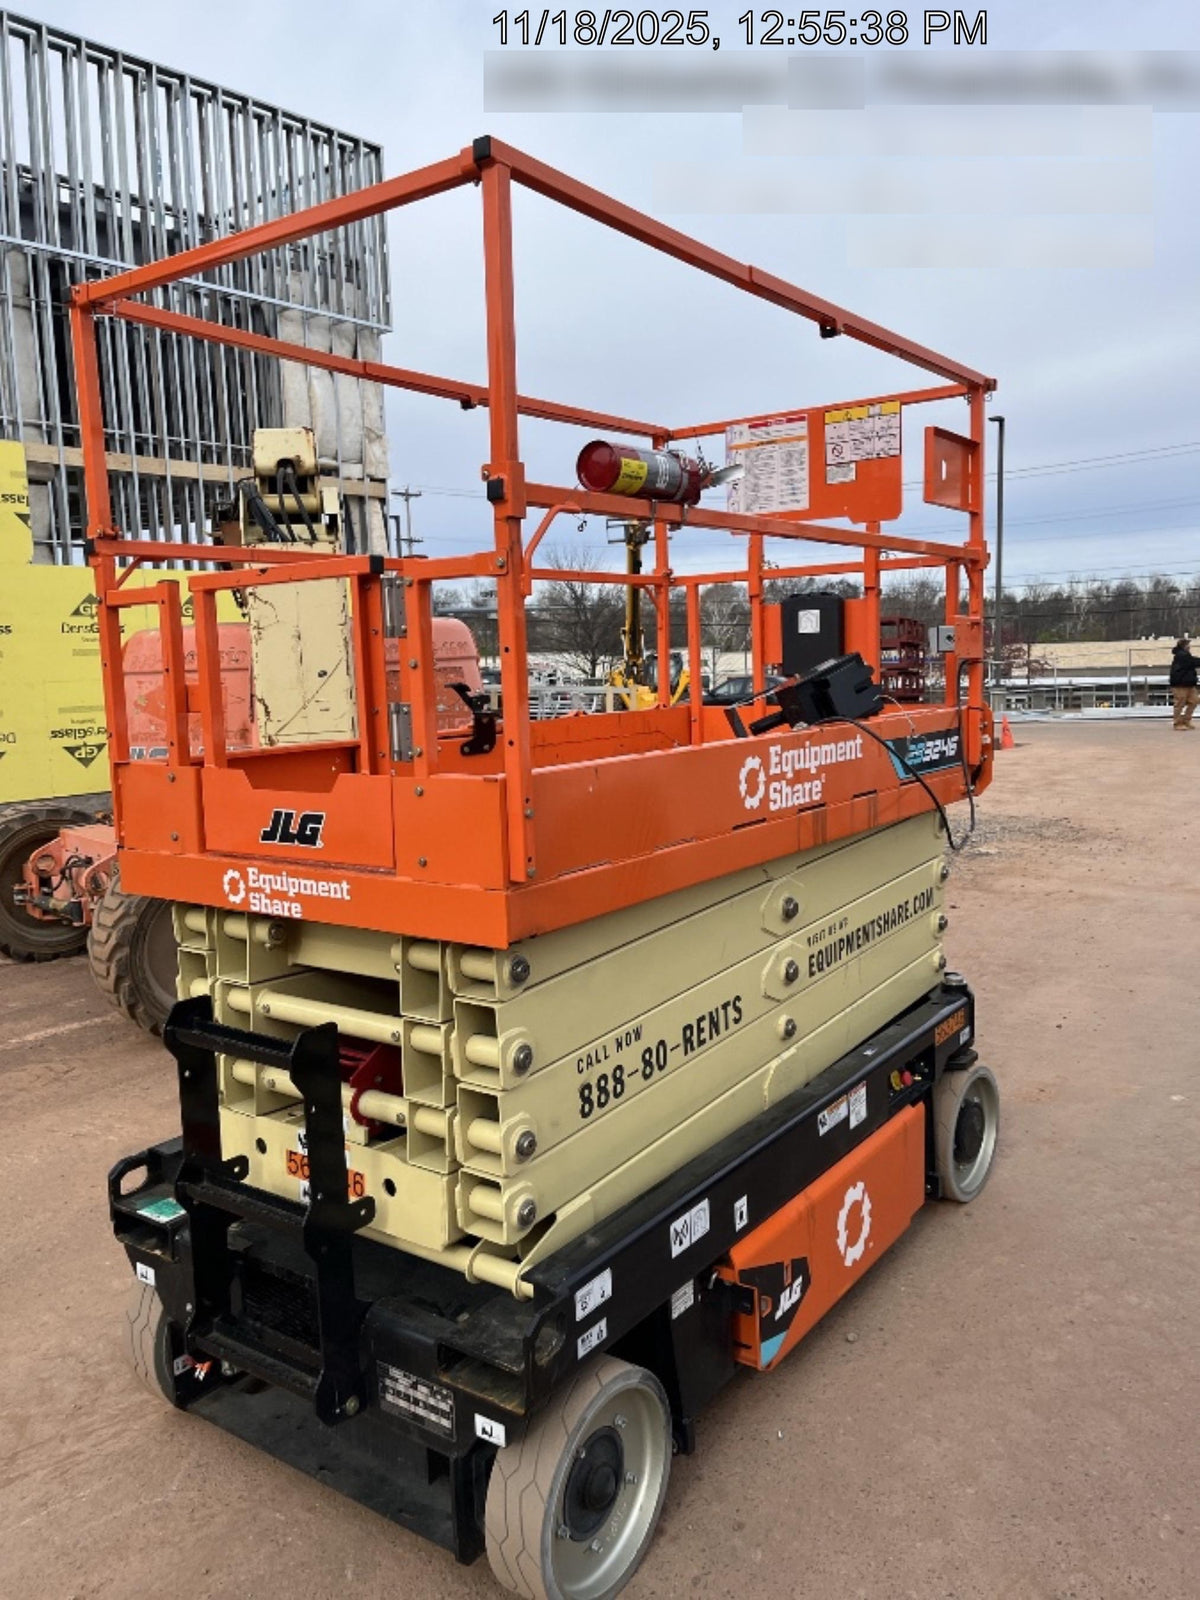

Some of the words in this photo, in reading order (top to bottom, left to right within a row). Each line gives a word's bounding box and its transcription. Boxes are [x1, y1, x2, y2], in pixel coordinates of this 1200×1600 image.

[768, 734, 863, 778] Equipment
[769, 779, 823, 811] Share
[258, 808, 326, 848] JLG
[246, 867, 351, 900] Equipment
[248, 892, 303, 918] Share
[808, 886, 934, 978] EQUIPMENTSHARE.COM
[576, 1044, 610, 1074] CALL
[615, 1023, 642, 1053] NOW
[578, 994, 742, 1119] 888-80-RENTS
[774, 1275, 803, 1321] JLG
